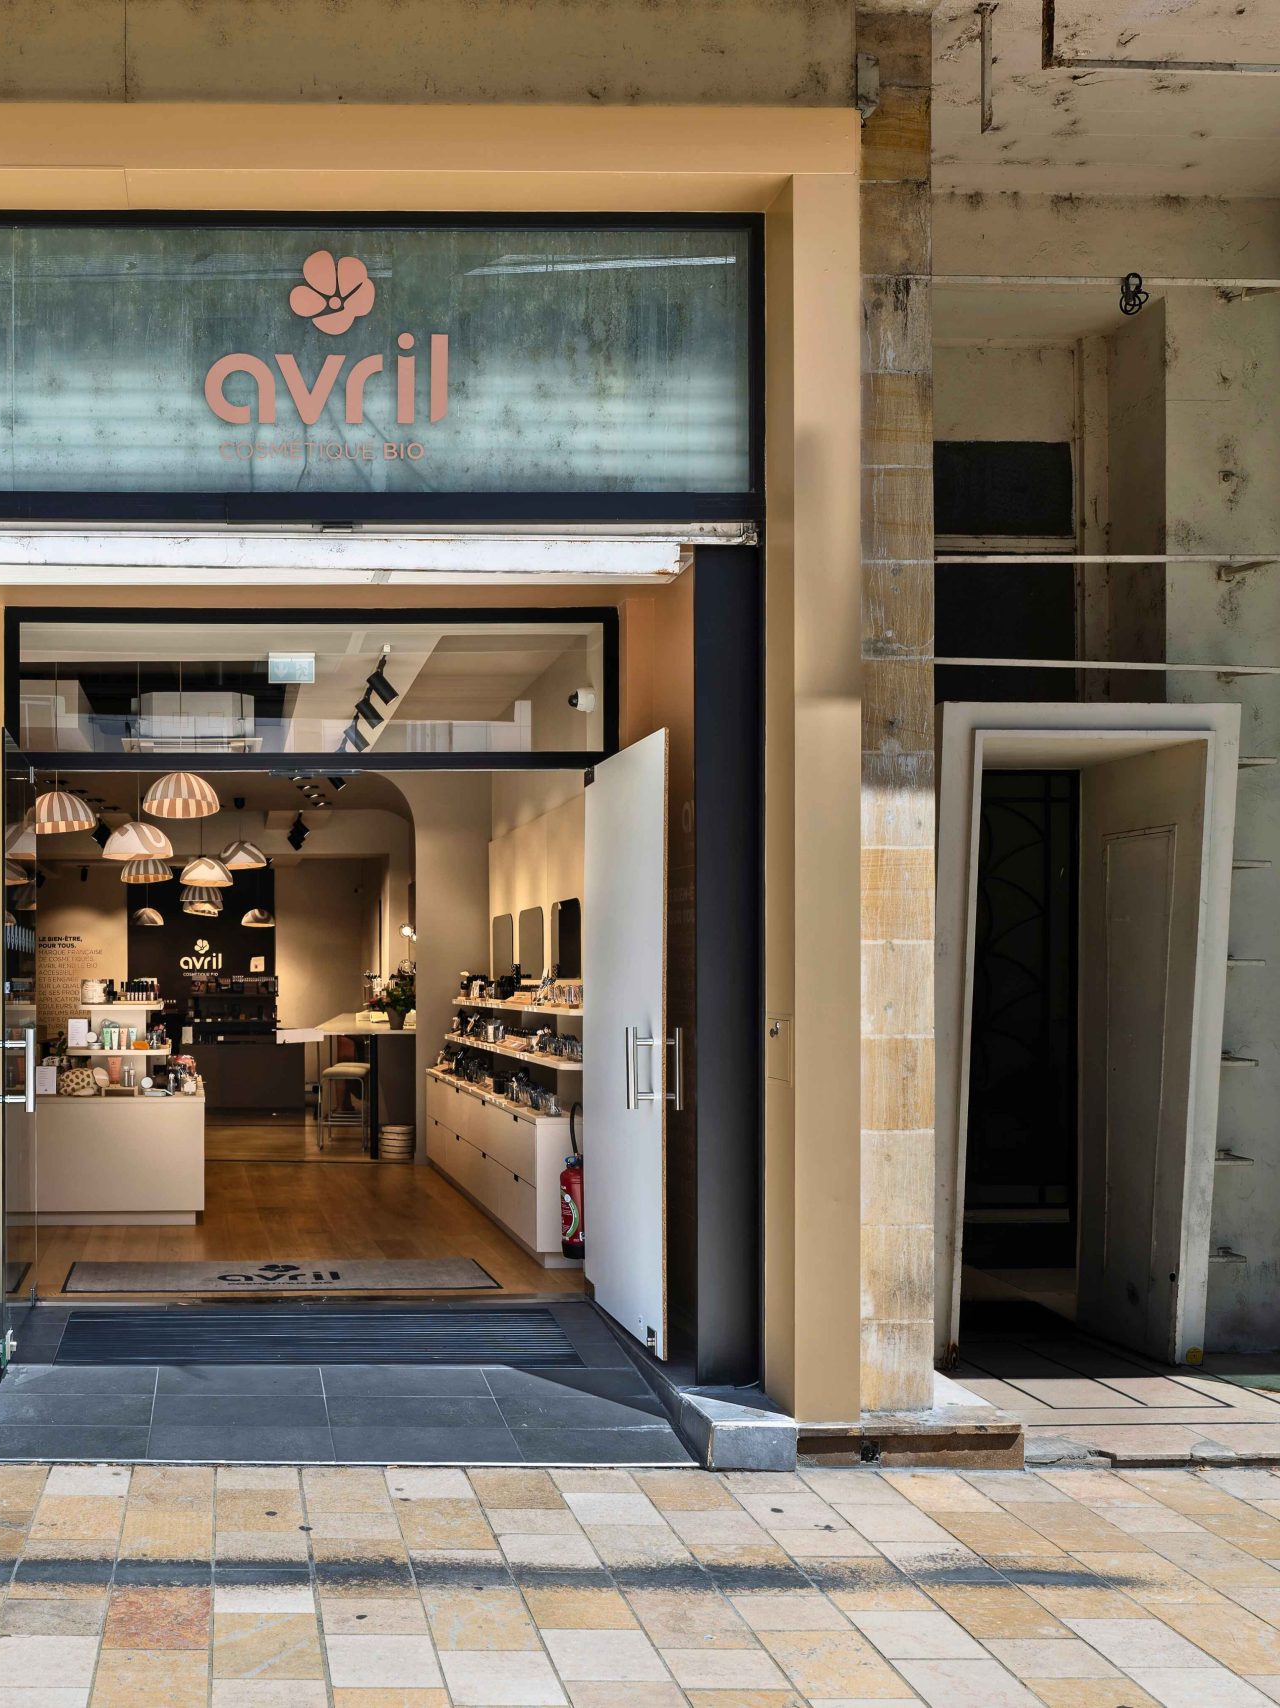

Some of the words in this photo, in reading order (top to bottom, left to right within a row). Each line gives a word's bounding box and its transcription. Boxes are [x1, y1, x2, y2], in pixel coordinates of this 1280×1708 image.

[204, 332, 449, 425] avril
[383, 442, 425, 460] BIO
[180, 952, 222, 970] avril
[217, 1272, 340, 1282] avril
